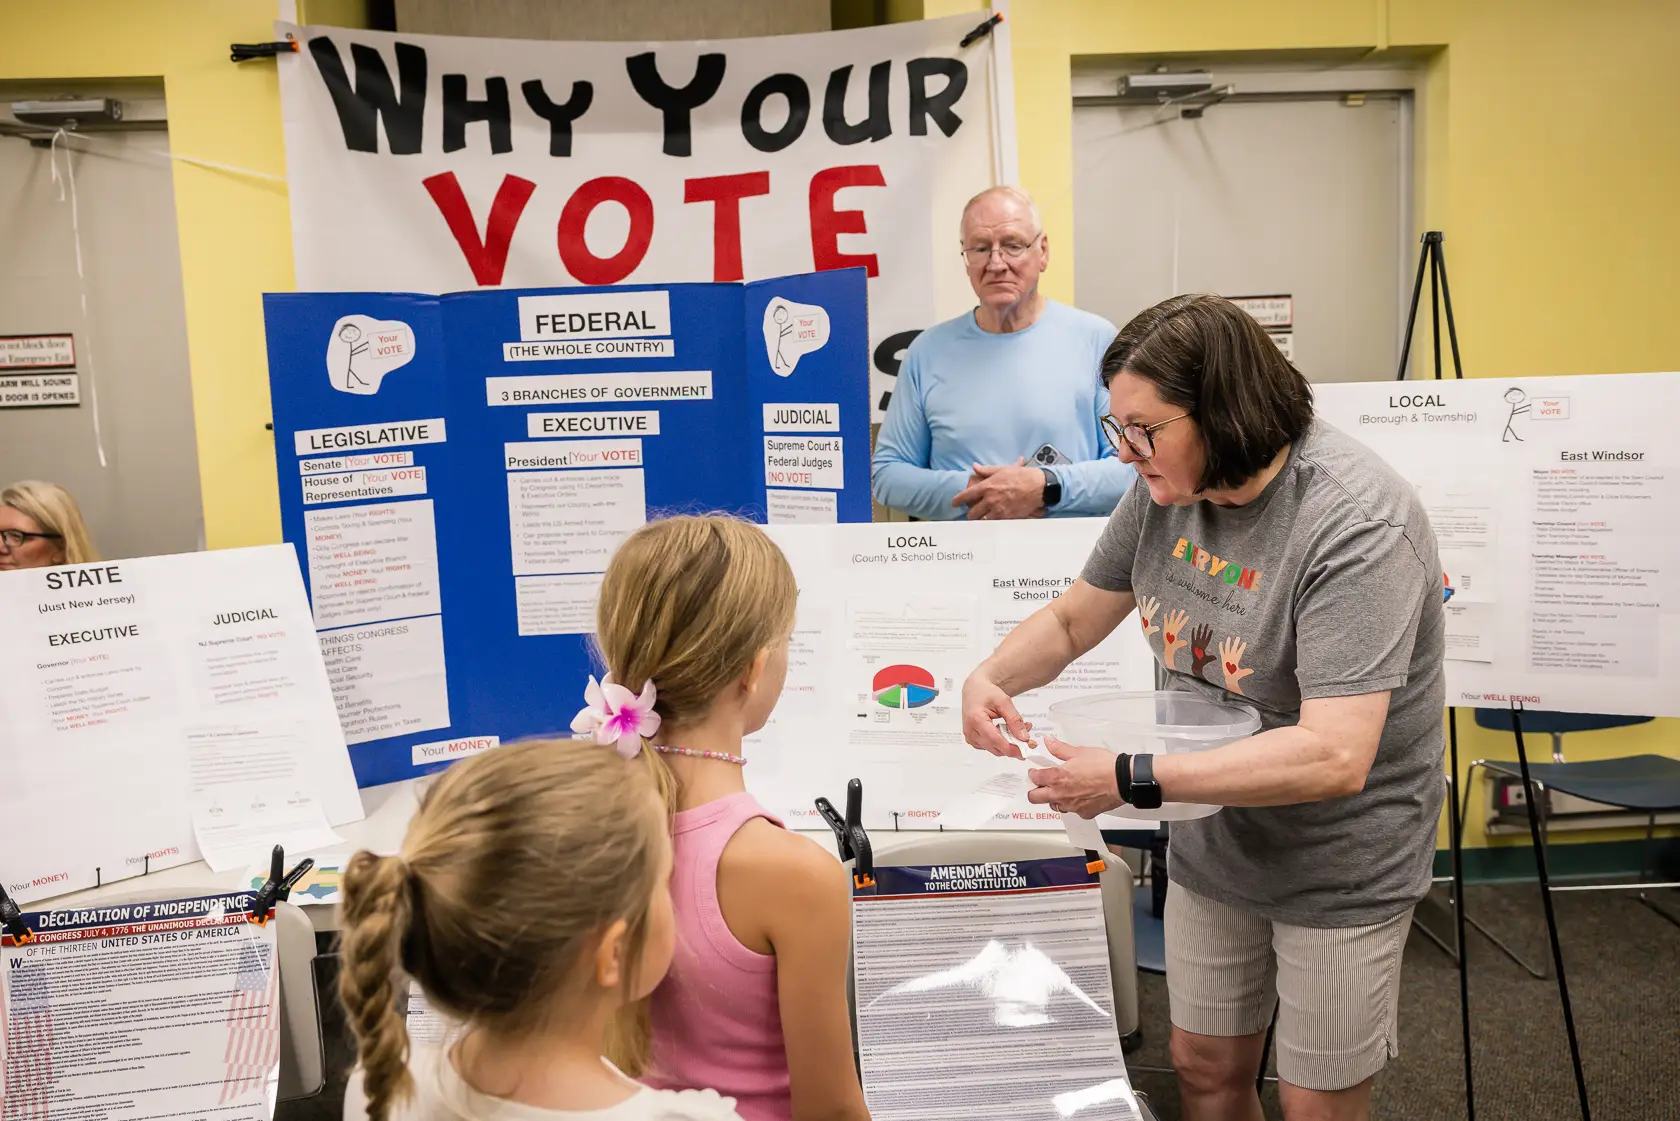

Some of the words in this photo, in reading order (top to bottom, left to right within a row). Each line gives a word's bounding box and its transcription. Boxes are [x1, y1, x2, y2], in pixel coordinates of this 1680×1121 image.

[309, 36, 593, 157] WHY
[626, 52, 968, 157] YOUR
[423, 165, 887, 285] VOTE
[536, 311, 656, 334] FEDERAL
[798, 330, 816, 339] VOTE
[377, 345, 403, 355] VOTE
[509, 345, 539, 359] (THE
[542, 343, 592, 355] WHOLE
[595, 341, 664, 353] COUNTRY)
[20, 380, 40, 388] WILL
[43, 379, 71, 387] SOUND
[42, 392, 76, 400] OPENED
[501, 391, 509, 401] 3
[513, 388, 587, 401] BRANCHES
[591, 388, 608, 398] OF
[614, 386, 708, 398] GOVERNMENT
[1389, 394, 1446, 408] LOCAL
[773, 410, 832, 424] JUDICIAL
[1359, 414, 1408, 425] (Borough
[1411, 413, 1419, 423] &
[1422, 412, 1477, 424] Township)
[543, 416, 647, 432] EXECUTIVE
[310, 425, 428, 450] LEGISLATIVE
[768, 440, 804, 452] Supreme
[807, 440, 831, 451] Court
[834, 441, 840, 451] &
[508, 456, 567, 467] President
[1561, 451, 1588, 461] East
[1592, 450, 1645, 461] Windsor
[303, 460, 341, 471] Senate
[768, 456, 799, 467] Federal
[802, 457, 833, 470] Judges
[304, 476, 339, 487] House
[342, 475, 353, 484] of
[305, 486, 393, 502] Representatives
[888, 536, 937, 548] LOCAL
[852, 554, 888, 565] (County
[892, 553, 898, 562] &
[901, 552, 934, 562] School
[937, 552, 973, 562] District)
[46, 567, 122, 590] STATE
[993, 579, 1015, 587] East
[1018, 578, 1061, 587] Windsor
[1013, 591, 1048, 599] School
[38, 602, 66, 614] (Just
[69, 599, 93, 609] New
[97, 594, 135, 607] Jersey)
[1222, 590, 1247, 616] here
[213, 608, 278, 625] JUDICIAL
[48, 625, 139, 646] EXECUTIVE
[320, 633, 354, 646] THINGS
[356, 626, 409, 640] CONGRESS
[321, 644, 364, 657] AFFECTS:
[37, 660, 69, 670] Governor
[345, 655, 361, 663] Care
[327, 665, 340, 674] hild
[346, 672, 373, 682] Security
[331, 684, 356, 692] edicare
[344, 699, 372, 709] Benefits
[1461, 693, 1481, 701] (Your
[1483, 694, 1507, 702] WELL
[1510, 695, 1540, 704] BEING)
[363, 703, 401, 715] Protections
[421, 745, 444, 757] Your
[448, 740, 492, 753] MONEY
[930, 862, 1018, 880] AMENDMENTS
[10, 881, 30, 893] (Your
[33, 872, 69, 887] MONEY)
[950, 876, 1027, 889] CONSTITUTION
[39, 908, 130, 928] DECLARATION
[133, 907, 150, 919] OF
[154, 895, 249, 917] INDEPENDENCE
[40, 931, 82, 943] CONGRESS
[83, 928, 101, 938] JULY
[101, 928, 109, 938] 4,
[111, 925, 129, 935] 1776
[131, 924, 146, 933] THE
[148, 920, 194, 932] UNANIMOUS
[196, 915, 247, 927] DECLARATION
[26, 948, 38, 957] OF
[40, 946, 56, 955] THE
[59, 942, 97, 954] THIRTEEN
[101, 937, 138, 949] UNITED
[142, 933, 177, 944] STATES
[181, 931, 193, 941] OF
[196, 926, 240, 939] AMERICA
